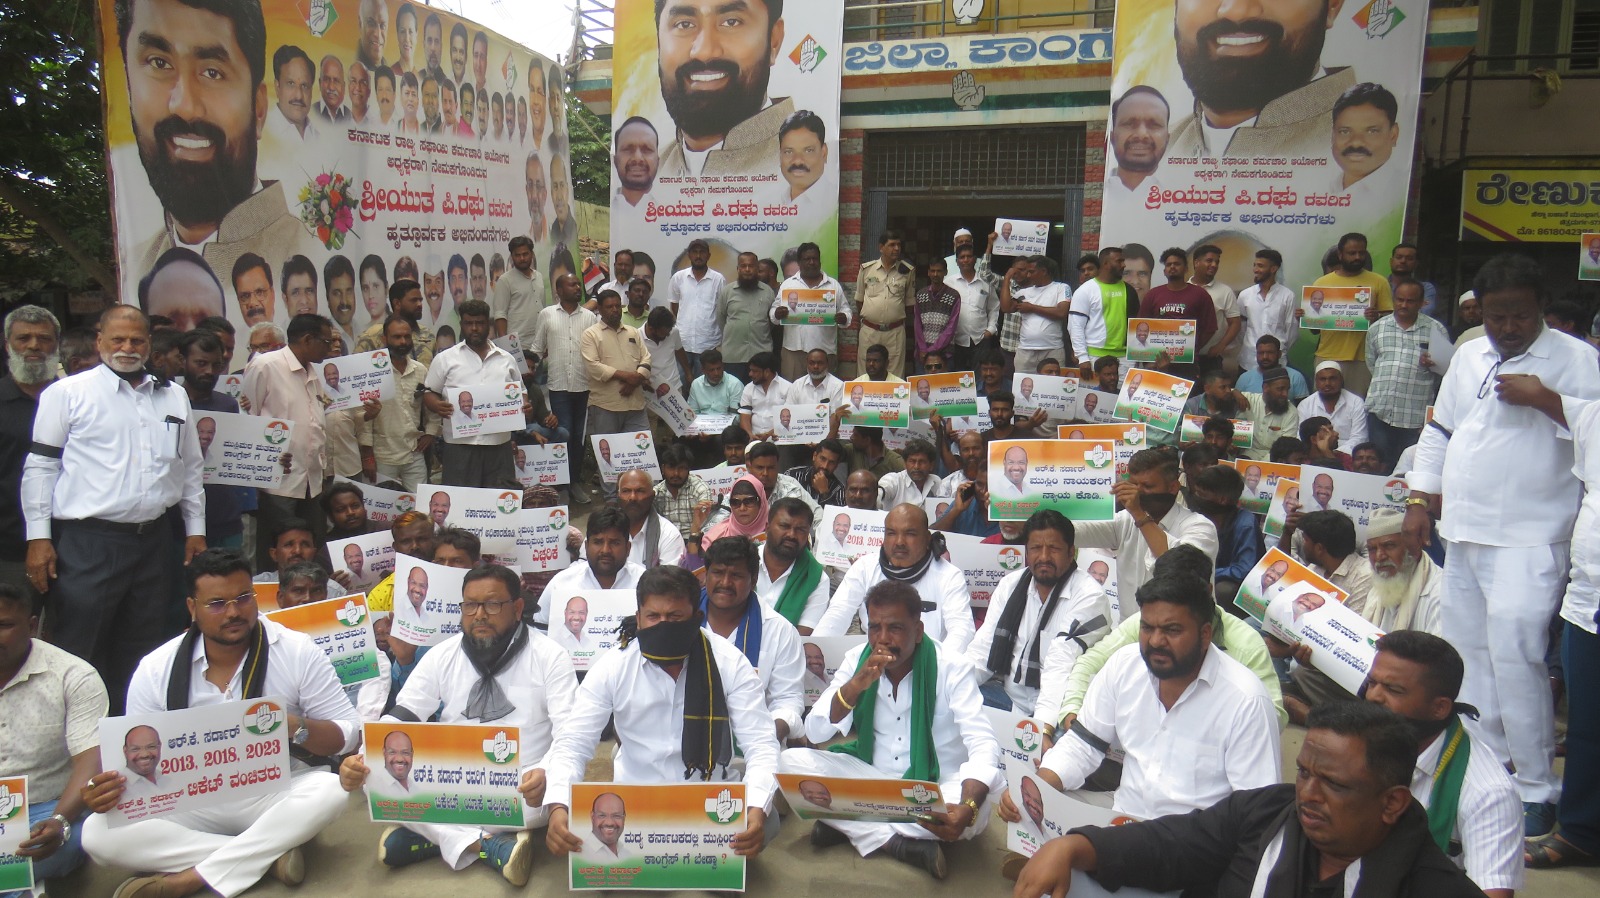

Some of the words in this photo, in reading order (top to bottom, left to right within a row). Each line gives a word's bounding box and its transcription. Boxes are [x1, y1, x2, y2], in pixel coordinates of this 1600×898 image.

[845, 41, 958, 71] ಜಿಲ್ಲಾ
[347, 127, 391, 146] ಕರ್ನಾಟಕ
[396, 136, 416, 157] ರಾಜ್ಯ
[420, 139, 448, 155] ಸಫಾಯಿ
[452, 144, 482, 161] ಕರ್ಮಚಾರಿ
[484, 149, 510, 165] ಆಯೋಗದ
[386, 155, 428, 177] ಅಧ್ಯಕ್ಷರಾಗಿ
[431, 158, 488, 180] ನೇಮಕಗೊಂಡಿರುವ
[1167, 156, 1199, 167] ಕರ್ನಾಟಕ
[1201, 157, 1219, 170] ರಾಜ್ಯ
[1221, 157, 1250, 167] ಸಫಾಯಿ
[1252, 156, 1287, 167] ಕರ್ಮಚಾರಿ
[1290, 157, 1328, 167] ಆಯೋಗದ
[659, 175, 682, 184] ಕರ್ನಾಟಕ
[685, 175, 698, 187] ರಾಜ್ಯ
[1194, 170, 1229, 183] ಅಧ್ಯಕ್ಷರಾಗಿ
[1231, 170, 1293, 180] ನೇಮಕಗೊಂಡಿರುವ
[680, 186, 705, 197] ಅಧ್ಯಕ್ಷರಾಗಿ
[1145, 185, 1227, 210] ಶ್ರೀಯುತ
[1235, 185, 1297, 210] ಪಿ.ರಘು
[1304, 192, 1351, 207] ರವರಿಗೆ
[358, 180, 435, 222] ಶ್ರೀಯುತ
[442, 187, 485, 221] ಪಿ.ರಘು
[488, 200, 513, 218] ರವರಿಗೆ
[645, 200, 705, 223] ಶ್ರೀಯುತ
[712, 199, 758, 219] ಪಿ.ರಘು
[763, 204, 798, 217] ರವರಿಗೆ
[1164, 210, 1233, 227] ಹೃತ್ಪೂರ್ವಕ
[1239, 211, 1336, 226] ಅಭಿನಂದನೆಗಳು
[386, 225, 446, 250] ಹೃತ್ಪೂರ್ವಕ
[451, 227, 511, 244] ಅಭಿನಂದನೆಗಳು
[660, 221, 711, 237] ಹೃತ್ಪೂರ್ವಕ
[716, 221, 789, 233] ಅಭಿನಂದನೆಗಳು
[1159, 305, 1185, 316] MONEY
[1035, 464, 1056, 472] ಆರ್.ಕೆ.
[1060, 464, 1086, 473] ಸರ್ದಾರ್
[1029, 476, 1058, 487] ಮುಸ್ಲಿಂ
[1063, 476, 1112, 486] ನಾಯಕರಿಗೆ
[1042, 491, 1071, 503] ನ್ಯಾಯ
[532, 545, 560, 569] ಎಚ್ಚರಿಕೆ
[426, 599, 443, 614] ಆರ್.ಕೆ.
[594, 615, 614, 623] ಆರ್.ಕೆ.
[168, 732, 200, 750] ಆರ್.ಕೆ.
[204, 724, 241, 744] ಸರ್ದಾರ್
[161, 755, 199, 777] 2013,
[204, 746, 241, 768] 2018,
[246, 738, 282, 760] 2023
[187, 773, 224, 797] ಟಿಕೆಟ್
[229, 763, 282, 789] ವಂಚಿತರು
[413, 765, 435, 784] ಆರ್.ಕೆ.
[437, 766, 463, 785] ಸರ್ದಾರ್
[465, 767, 486, 786] ರವರಿಗೆ
[488, 768, 519, 790] ವಿಧಾನಸಭೆ
[116, 797, 146, 811] ಆರ್.ಕೆ.
[150, 789, 185, 804] ಸರ್ದಾರ್
[376, 799, 400, 808] ಆರ್.ಕೆ.
[403, 801, 431, 809] ಸರ್ದಾರ್
[464, 794, 485, 811] ಯಾಕೆ
[514, 797, 519, 812] ?
[647, 831, 699, 848] ಕರ್ನಾಟಕದಲ್ಲಿ
[644, 852, 680, 869] ಕಾಂಗ್ರೆಸ್
[682, 853, 690, 865] ಗೆ
[721, 852, 727, 865] ?
[578, 865, 606, 875] ಆರ್.ಕೆ.
[610, 866, 643, 875] ಸರ್ದಾರ್
